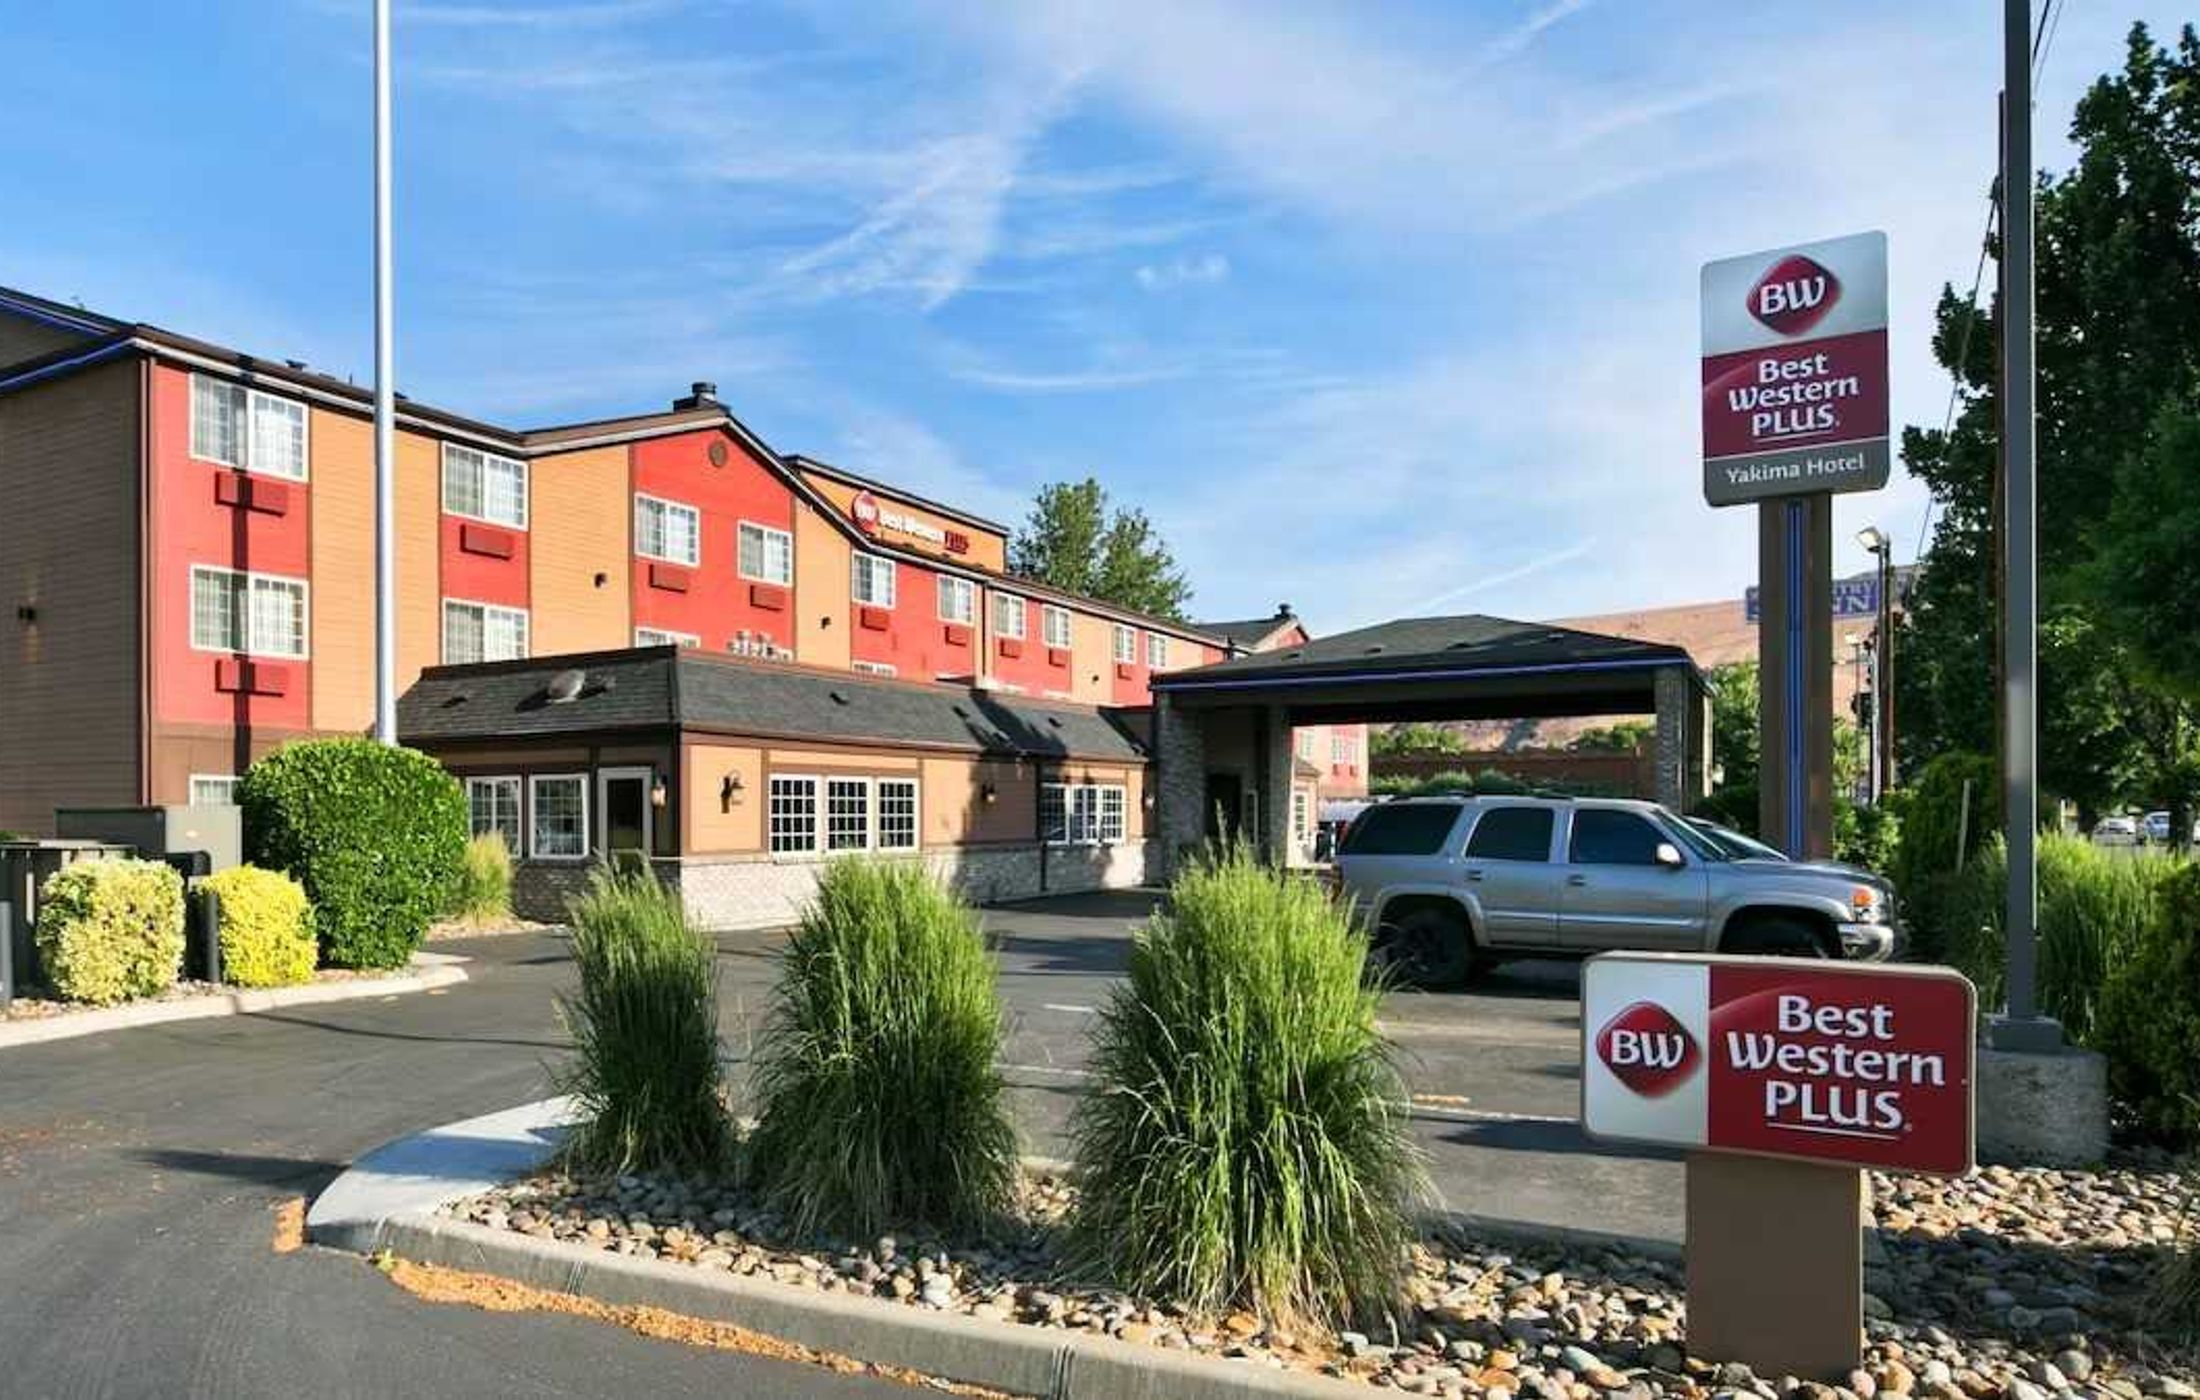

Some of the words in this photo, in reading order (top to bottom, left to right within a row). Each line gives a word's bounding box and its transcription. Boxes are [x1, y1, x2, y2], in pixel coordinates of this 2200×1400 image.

[1759, 276, 1826, 315] BW
[1758, 352, 1829, 384] Best
[1728, 376, 1859, 412] Western
[1752, 403, 1835, 436] PLUS
[1726, 461, 1800, 484] Yakima
[1807, 453, 1865, 475] Hotel
[1778, 994, 1895, 1040] Best
[1610, 1030, 1684, 1069] BW
[1726, 1030, 1945, 1086] Western
[1765, 1079, 1904, 1131] PLUS
